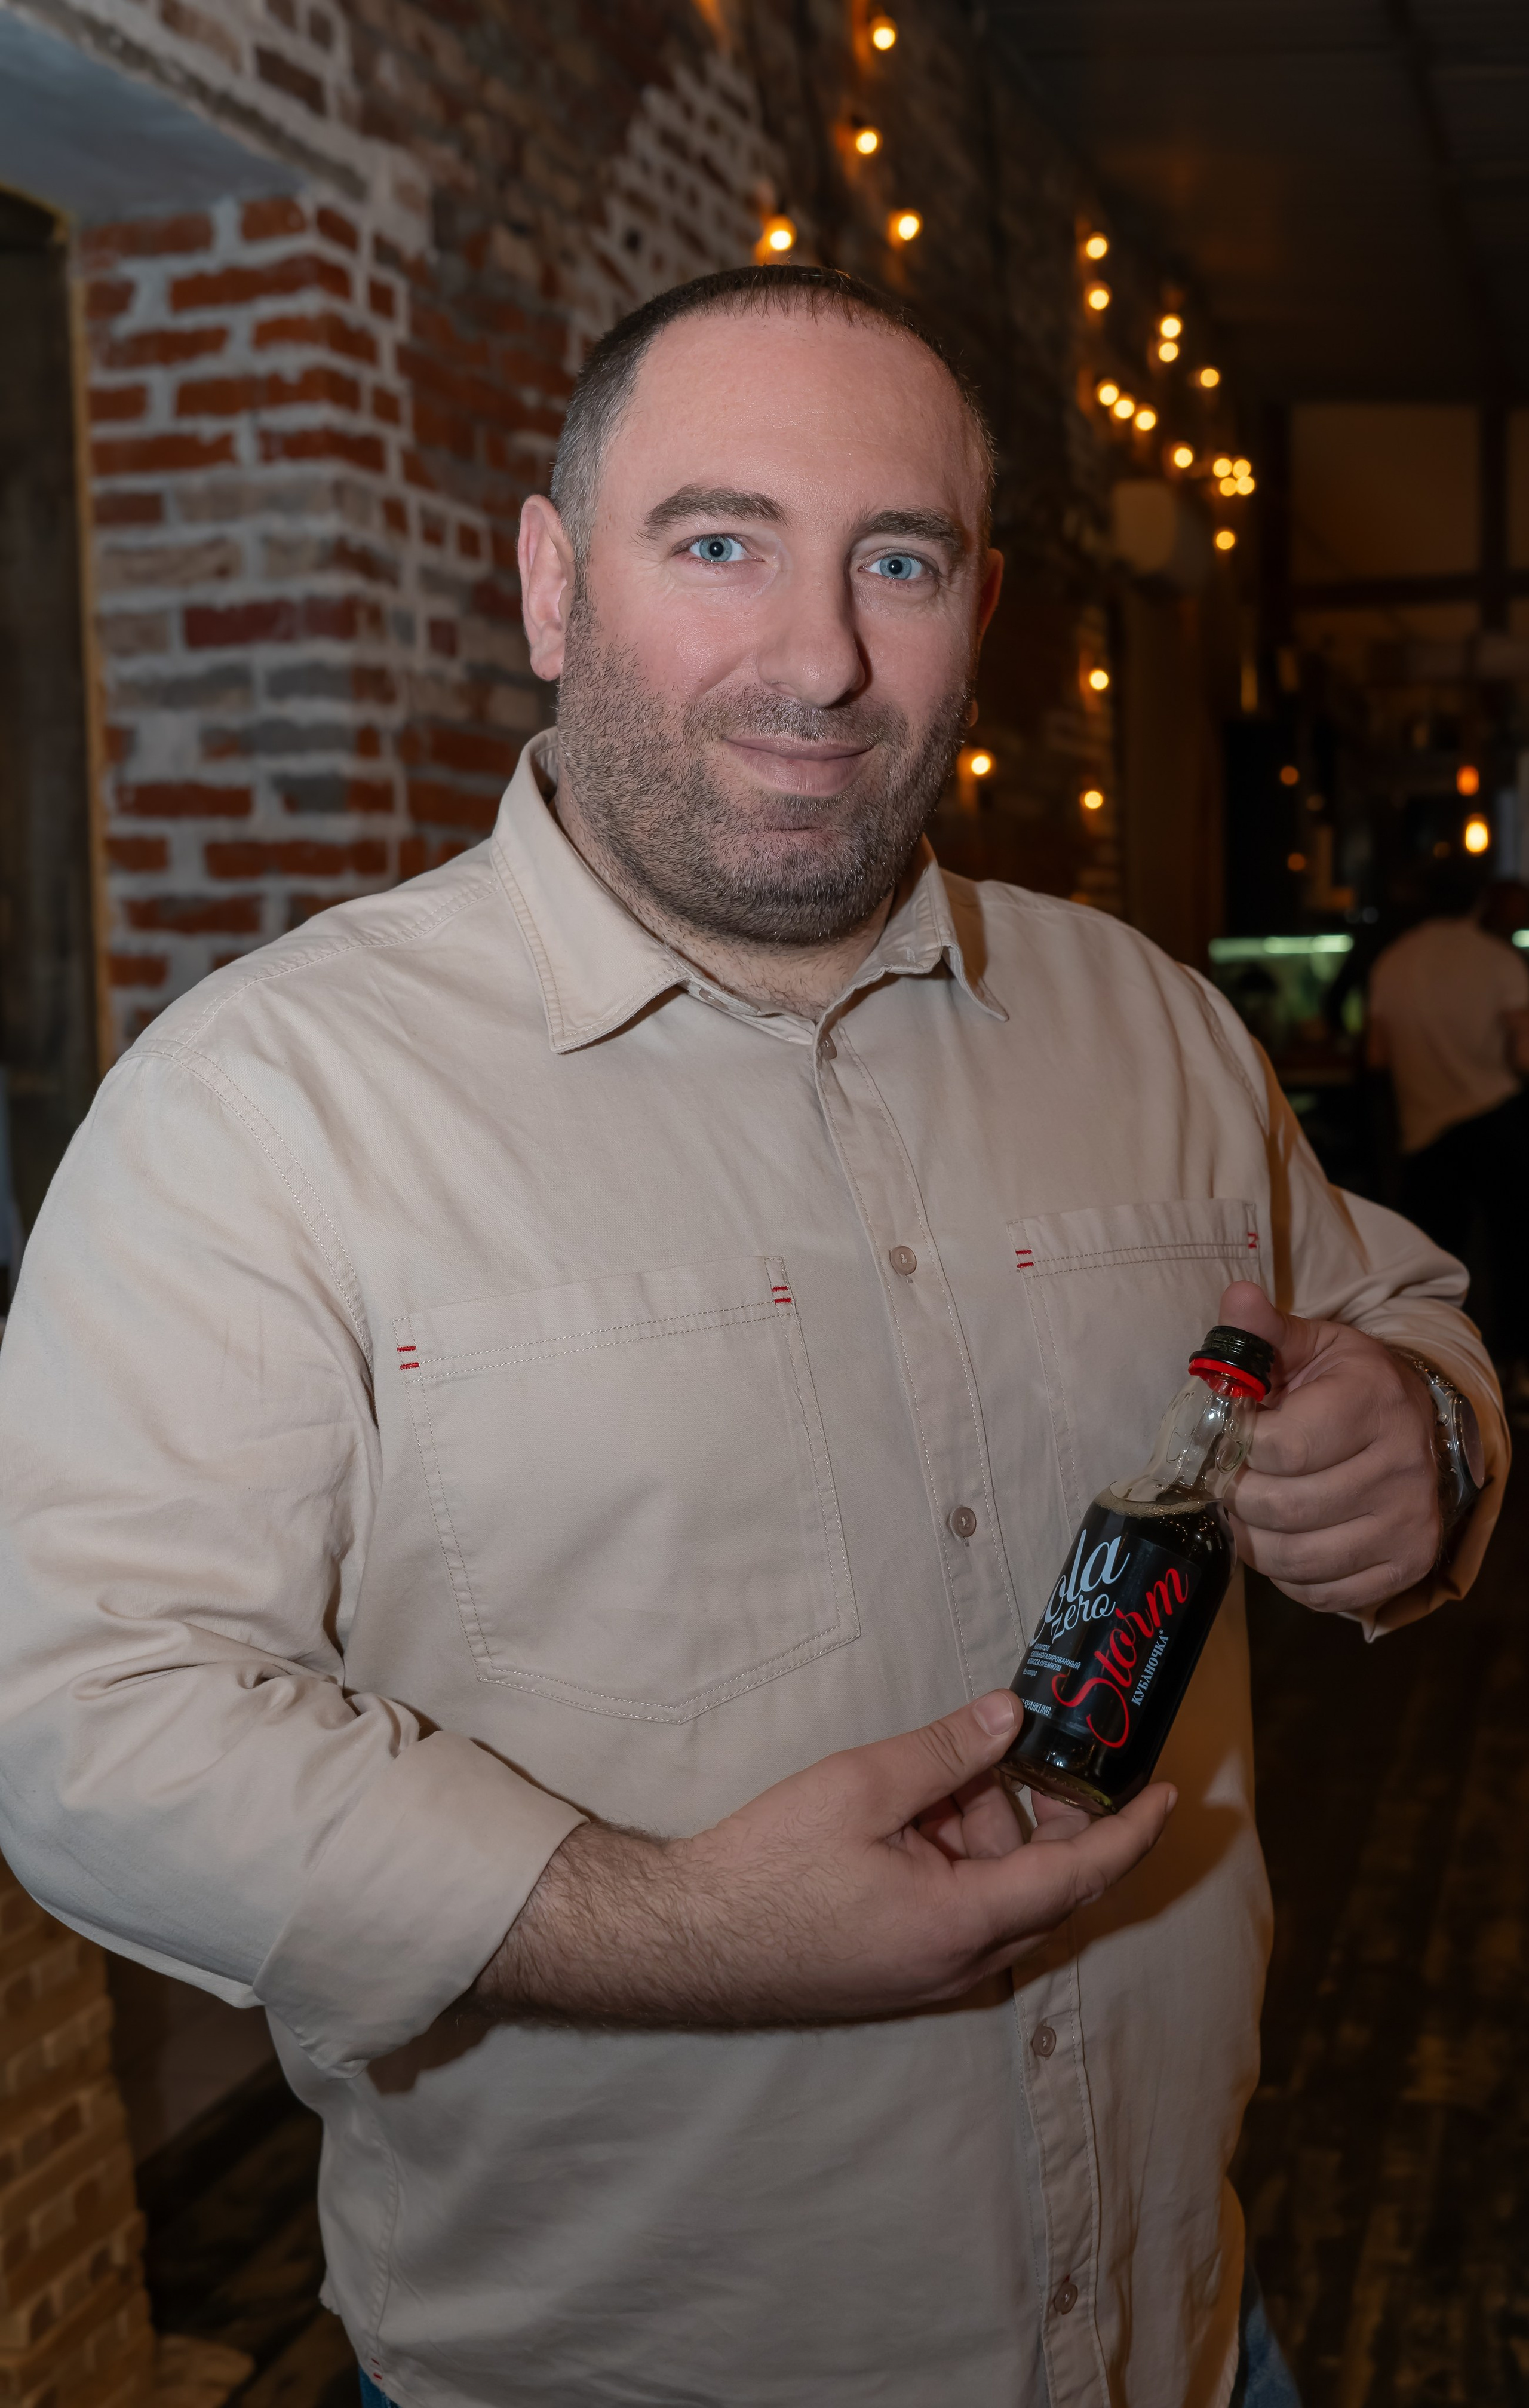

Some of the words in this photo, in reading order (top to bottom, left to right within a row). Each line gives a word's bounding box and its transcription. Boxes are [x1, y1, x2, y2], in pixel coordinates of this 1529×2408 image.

[1051, 1594, 1116, 1644] zero
[1039, 1659, 1063, 1672] ПРЕМИУМ
[1052, 1568, 1188, 1748] Storm
[1131, 1635, 1169, 1707] КУБАНОЧКА
[1024, 1699, 1052, 1716] SPARKLING
